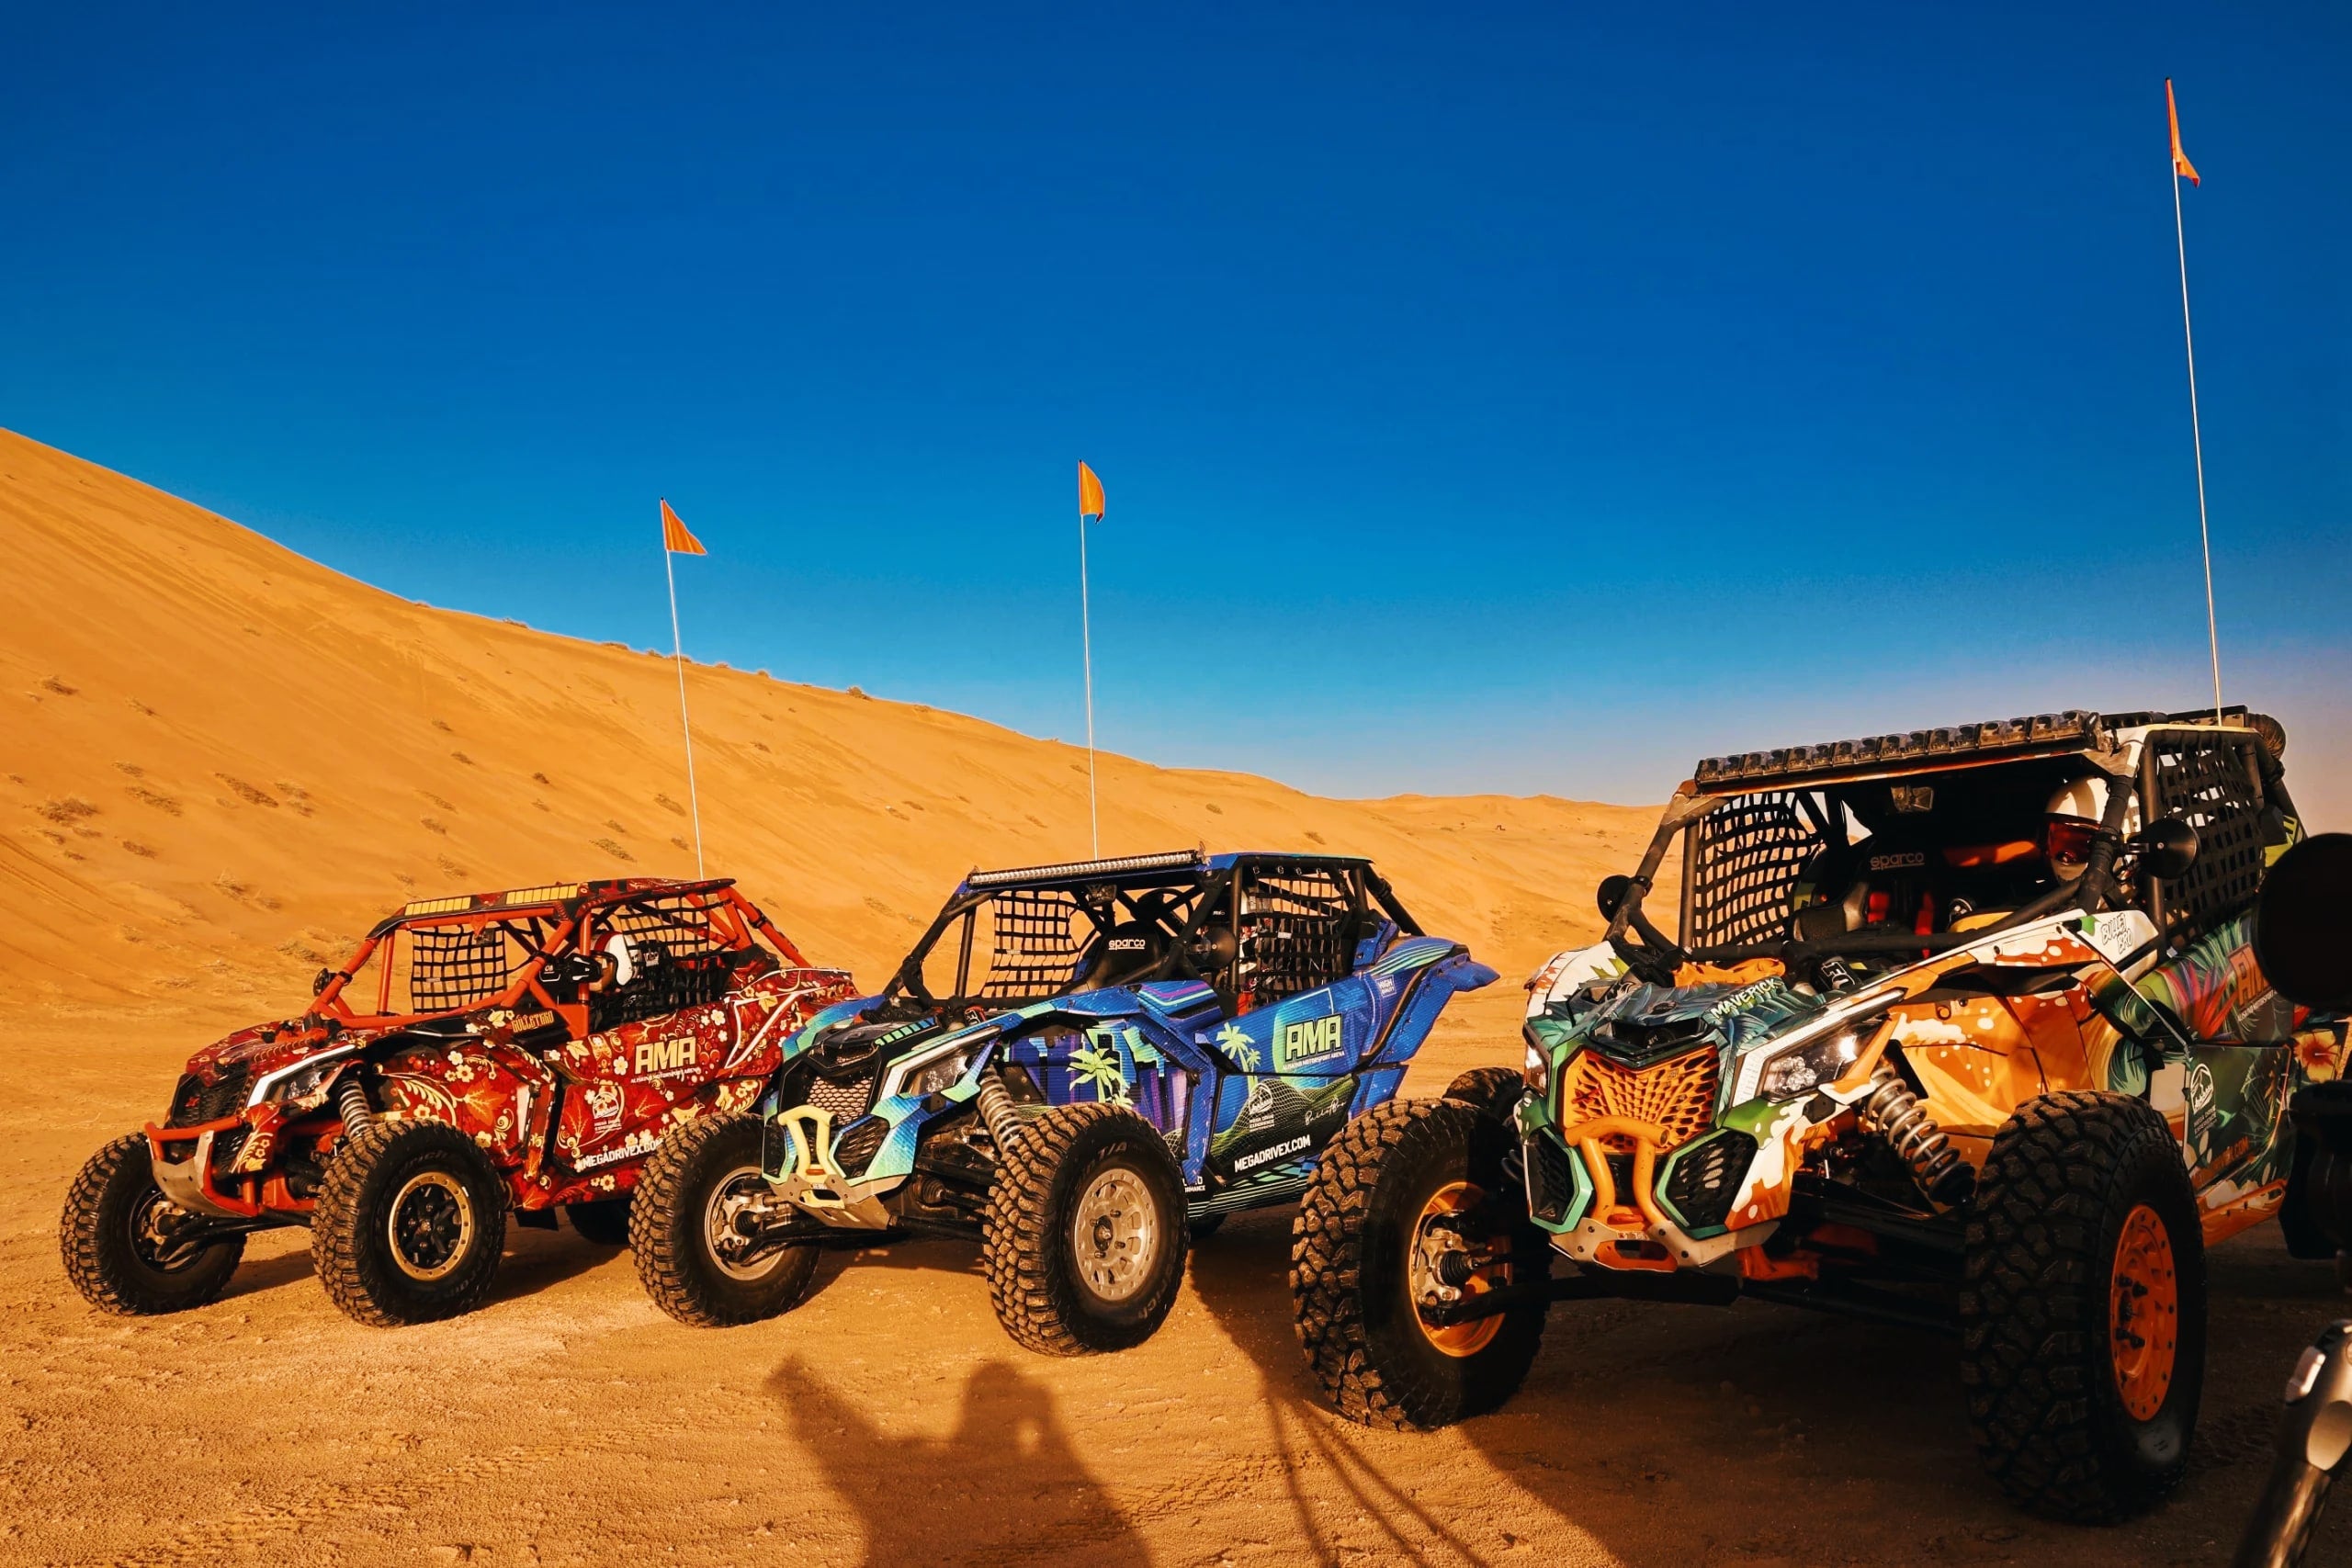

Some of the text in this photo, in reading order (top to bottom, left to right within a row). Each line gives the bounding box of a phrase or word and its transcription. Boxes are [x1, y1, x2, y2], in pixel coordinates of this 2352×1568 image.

[1870, 852, 1925, 870] sparco
[1108, 939, 1146, 950] sparco
[2117, 928, 2132, 955] BRO
[2230, 946, 2269, 1007] AM
[1711, 978, 1778, 1019] MAVERICK
[635, 1035, 696, 1075] AMA
[1285, 1014, 1342, 1061] AMA
[1234, 1134, 1311, 1173] MEGADRIVEX.COM
